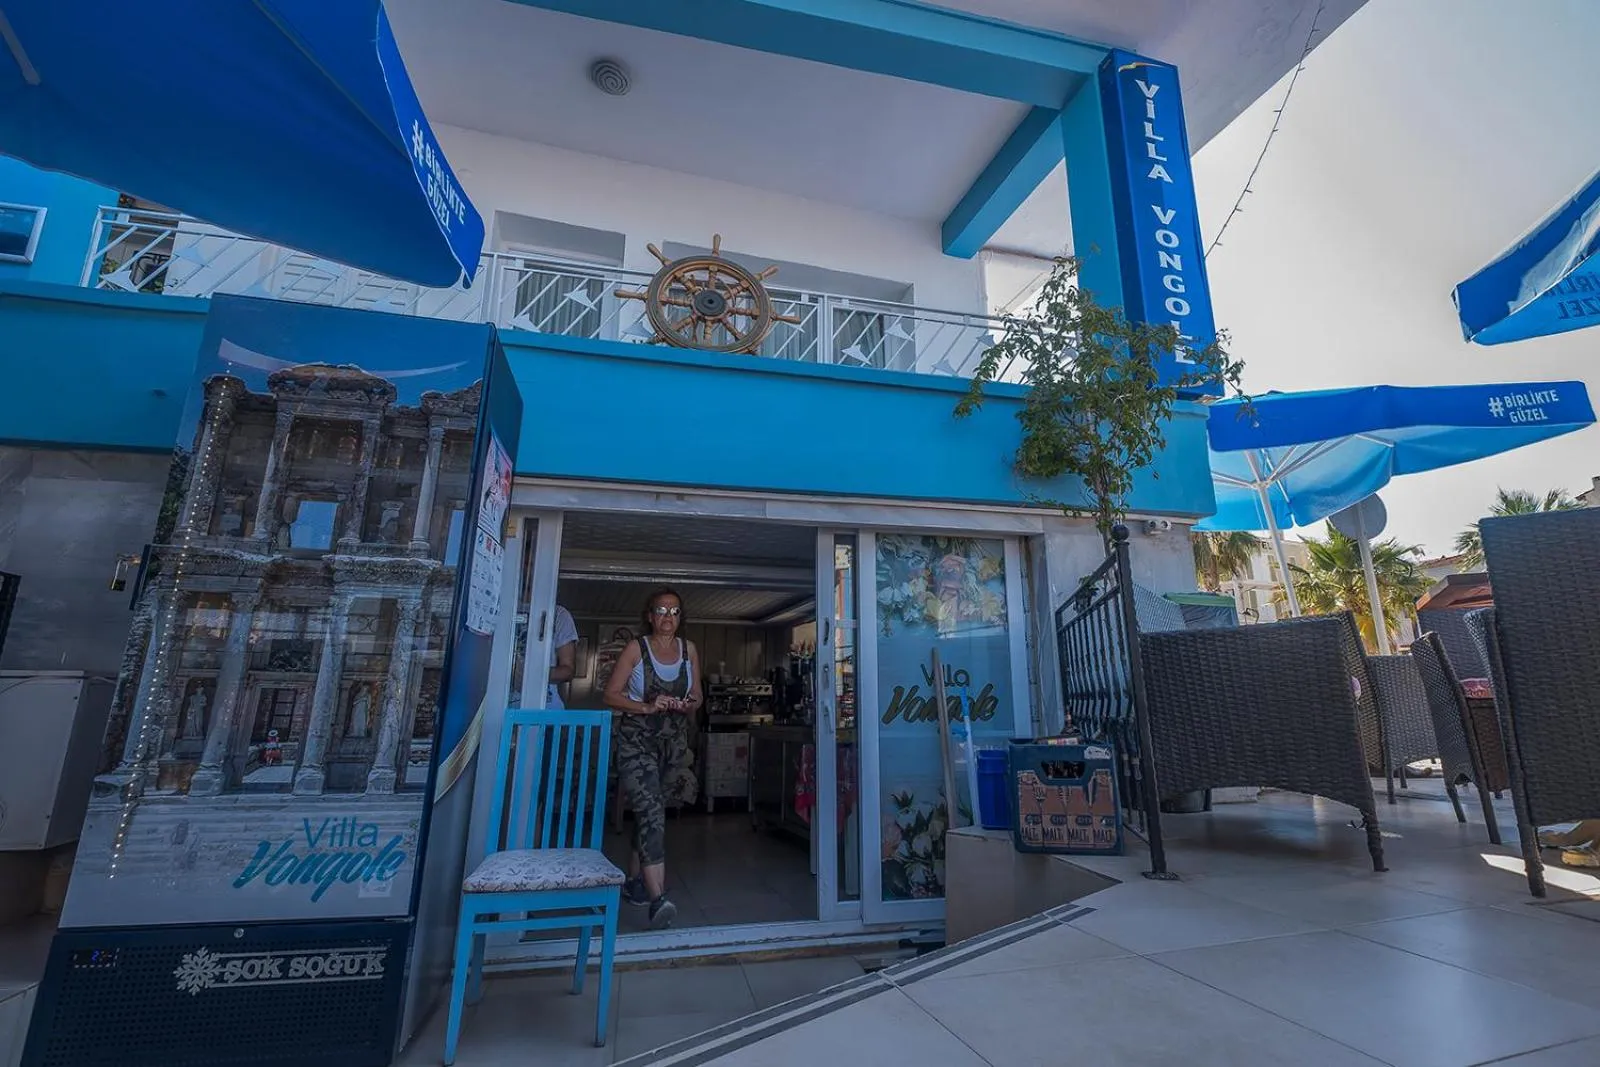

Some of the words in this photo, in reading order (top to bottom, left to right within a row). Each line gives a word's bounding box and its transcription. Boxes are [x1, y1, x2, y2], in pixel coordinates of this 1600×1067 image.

[1508, 407, 1548, 423] GÜZEL
[920, 663, 970, 687] Vlla
[303, 816, 380, 849] Villa
[232, 834, 408, 904] Vongole
[223, 955, 285, 984] ŞOK
